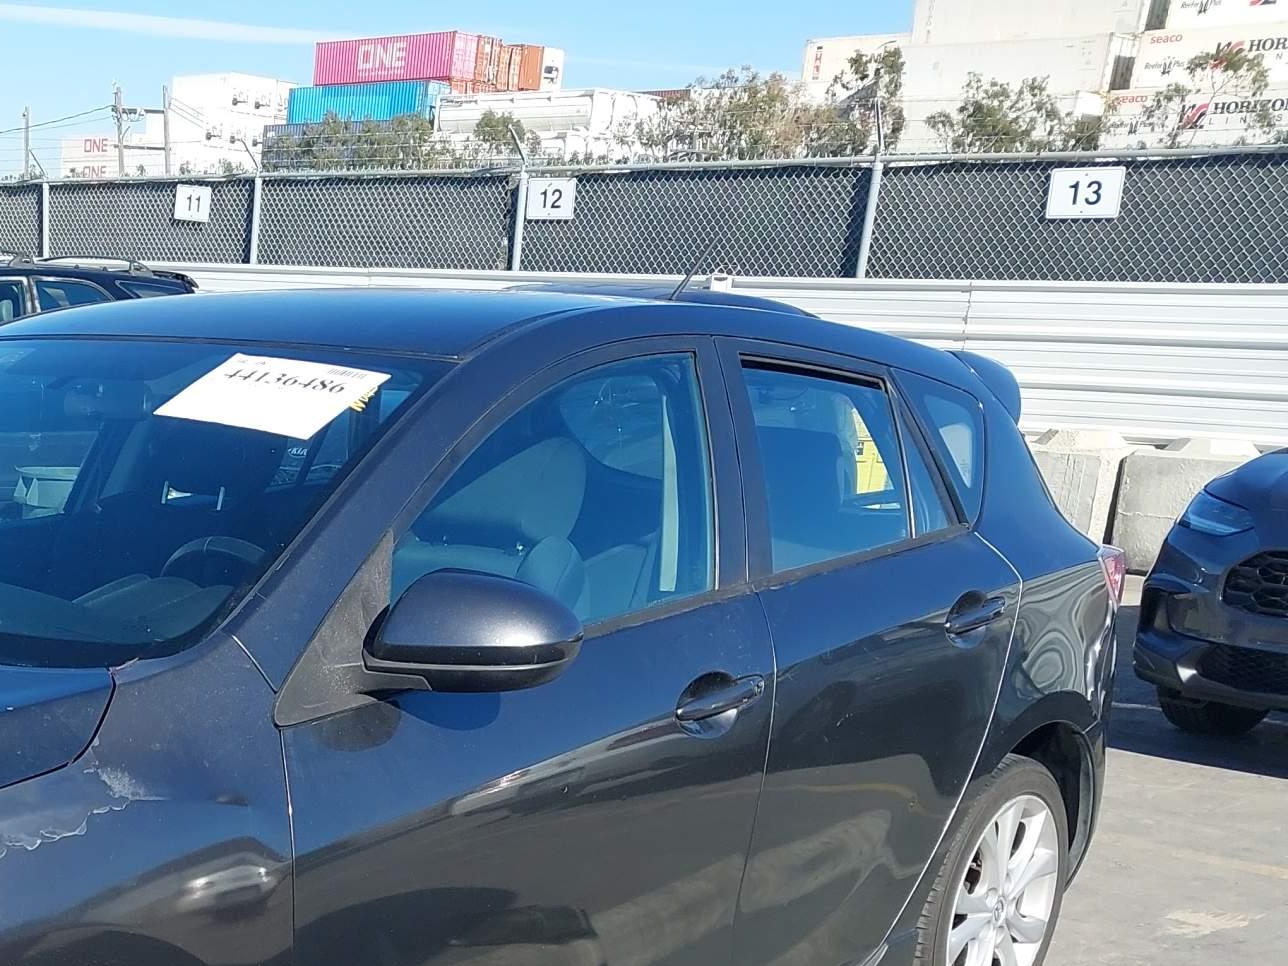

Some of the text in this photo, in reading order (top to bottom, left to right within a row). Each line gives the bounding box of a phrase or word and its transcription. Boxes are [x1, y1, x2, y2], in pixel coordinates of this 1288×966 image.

[1150, 33, 1183, 44] seaco
[357, 41, 407, 70] ONE
[84, 138, 108, 153] ONE
[82, 165, 107, 178] ONE
[540, 188, 563, 209] 12
[1068, 180, 1103, 206] 13
[187, 194, 201, 212] 11
[224, 369, 346, 394] 44136486
[291, 447, 308, 456] KIA
